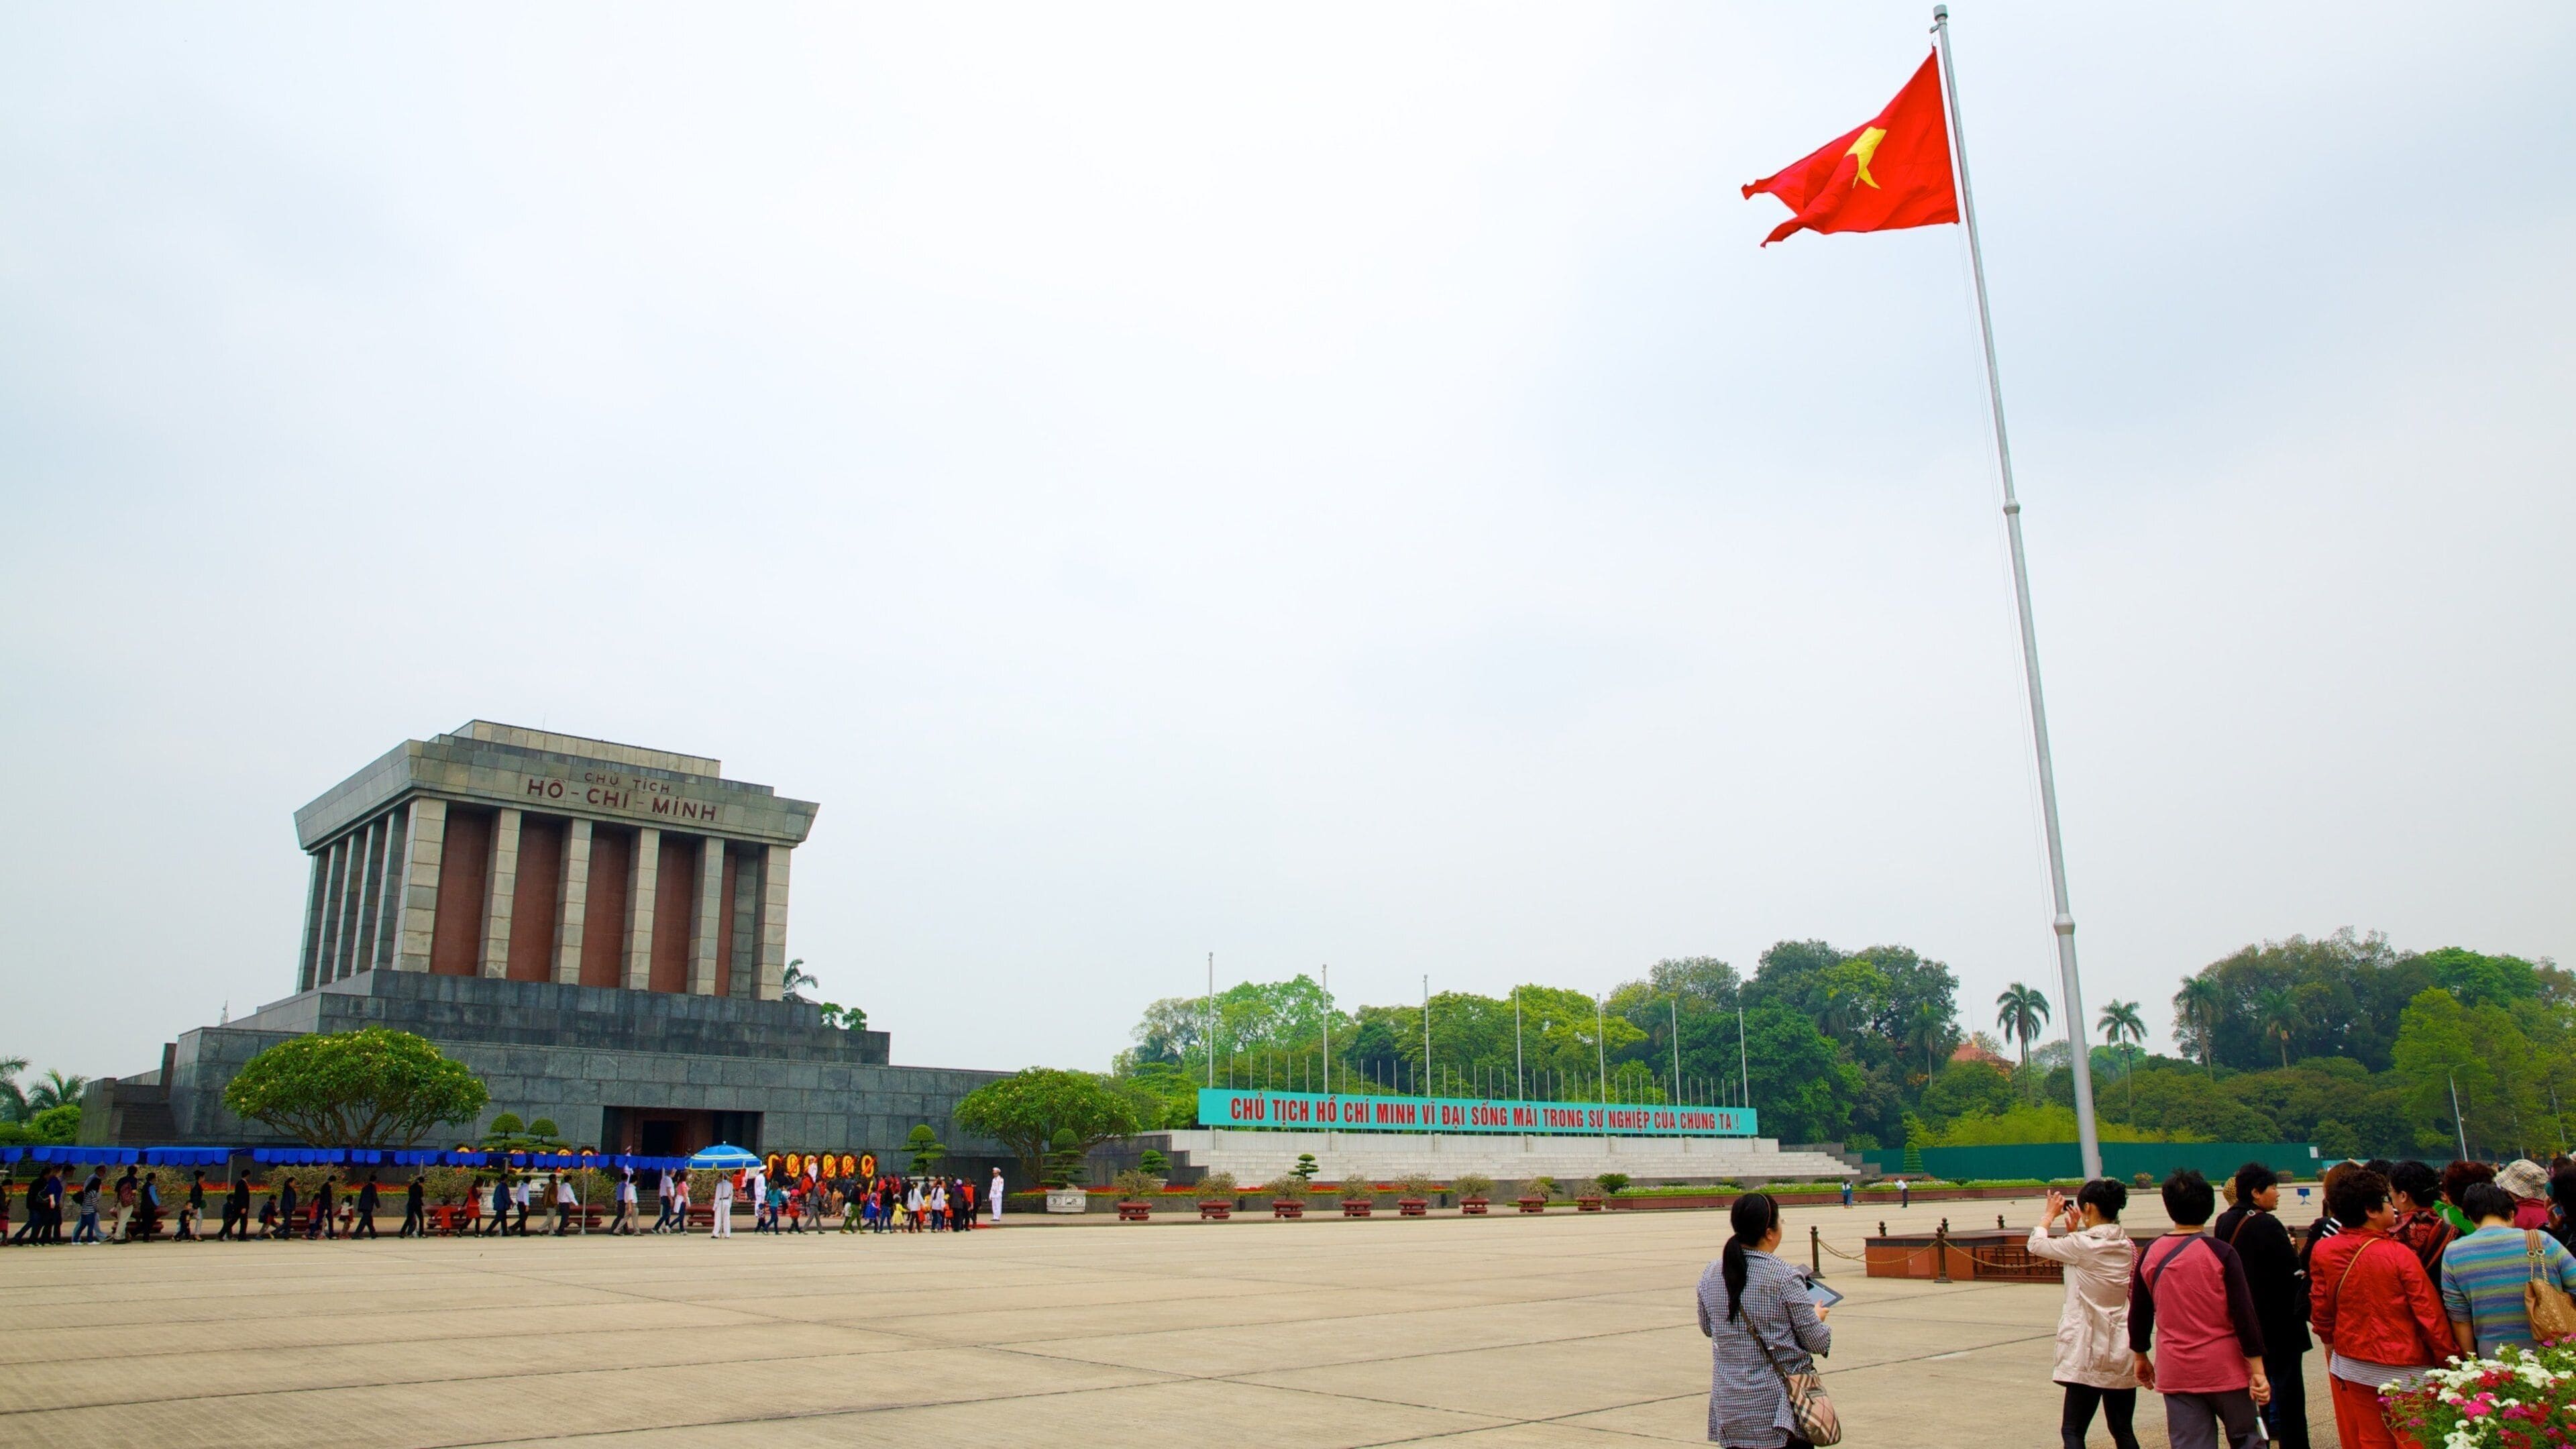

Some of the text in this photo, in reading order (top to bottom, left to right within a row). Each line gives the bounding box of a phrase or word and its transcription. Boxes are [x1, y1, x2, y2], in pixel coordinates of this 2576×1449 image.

[527, 779, 566, 798] HỒ
[586, 789, 631, 808] CHÍ
[1231, 1092, 1265, 1120] CHỦ
[1273, 1099, 1309, 1125] TỊCH
[1316, 1095, 1337, 1122] HỒ
[1344, 1098, 1370, 1124] CHÍ
[1377, 1104, 1415, 1124] MINH
[1422, 1101, 1435, 1124] VĨ
[1442, 1106, 1465, 1129] ĐẠI
[1471, 1101, 1507, 1126] SỐNG
[1513, 1104, 1538, 1126] MÃI
[1543, 1109, 1584, 1128] TRONG
[1589, 1108, 1604, 1132] SỰ
[1609, 1108, 1650, 1132] NGHIỆP
[1654, 1106, 1676, 1129] CỦA
[1680, 1109, 1715, 1129] CHÚNG
[1719, 1114, 1732, 1130] TA
